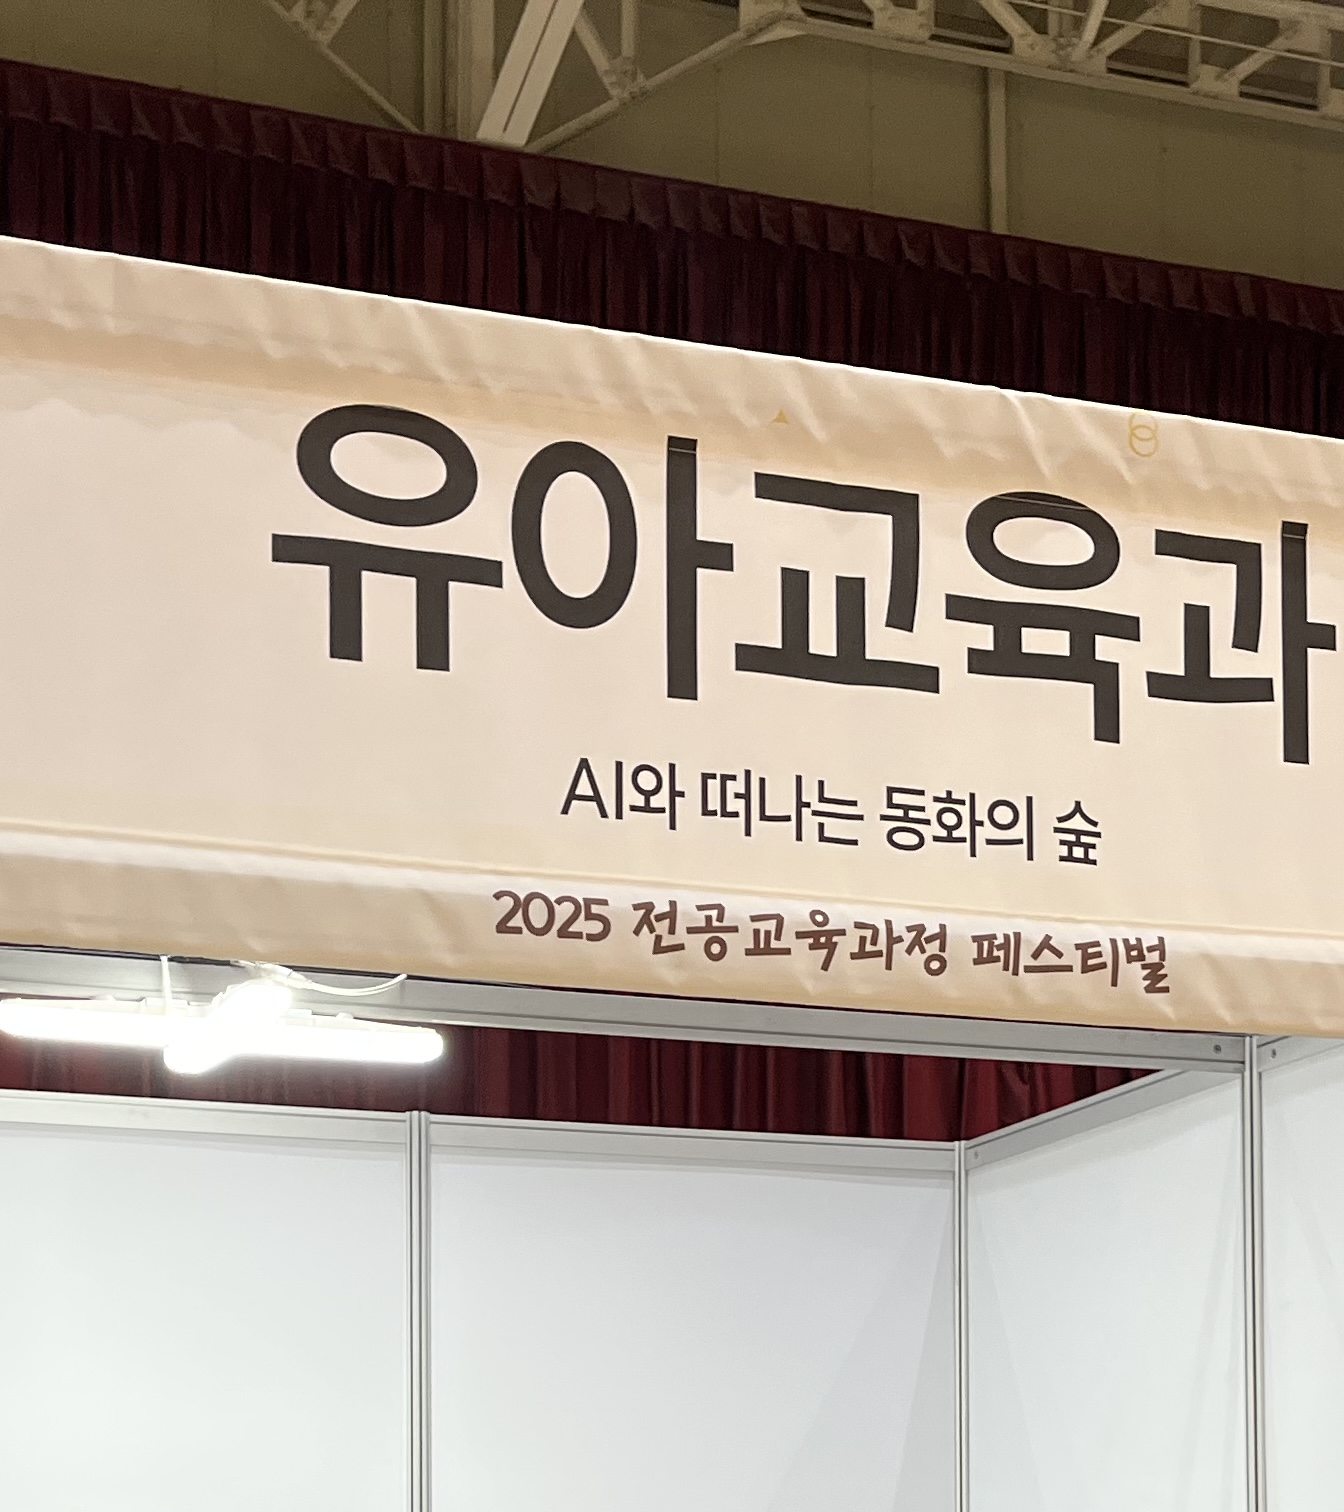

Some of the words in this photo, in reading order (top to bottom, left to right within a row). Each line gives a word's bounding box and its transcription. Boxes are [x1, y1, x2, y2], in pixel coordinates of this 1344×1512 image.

[271, 403, 1337, 764] 유아교육과
[560, 757, 686, 834] AI와
[700, 769, 864, 848] 떠나는
[878, 784, 1037, 863] 동화의
[1052, 799, 1103, 867] 숲
[492, 889, 612, 943] 2025
[631, 898, 949, 978] 전공교육과정
[970, 930, 1171, 995] 페스티벌
